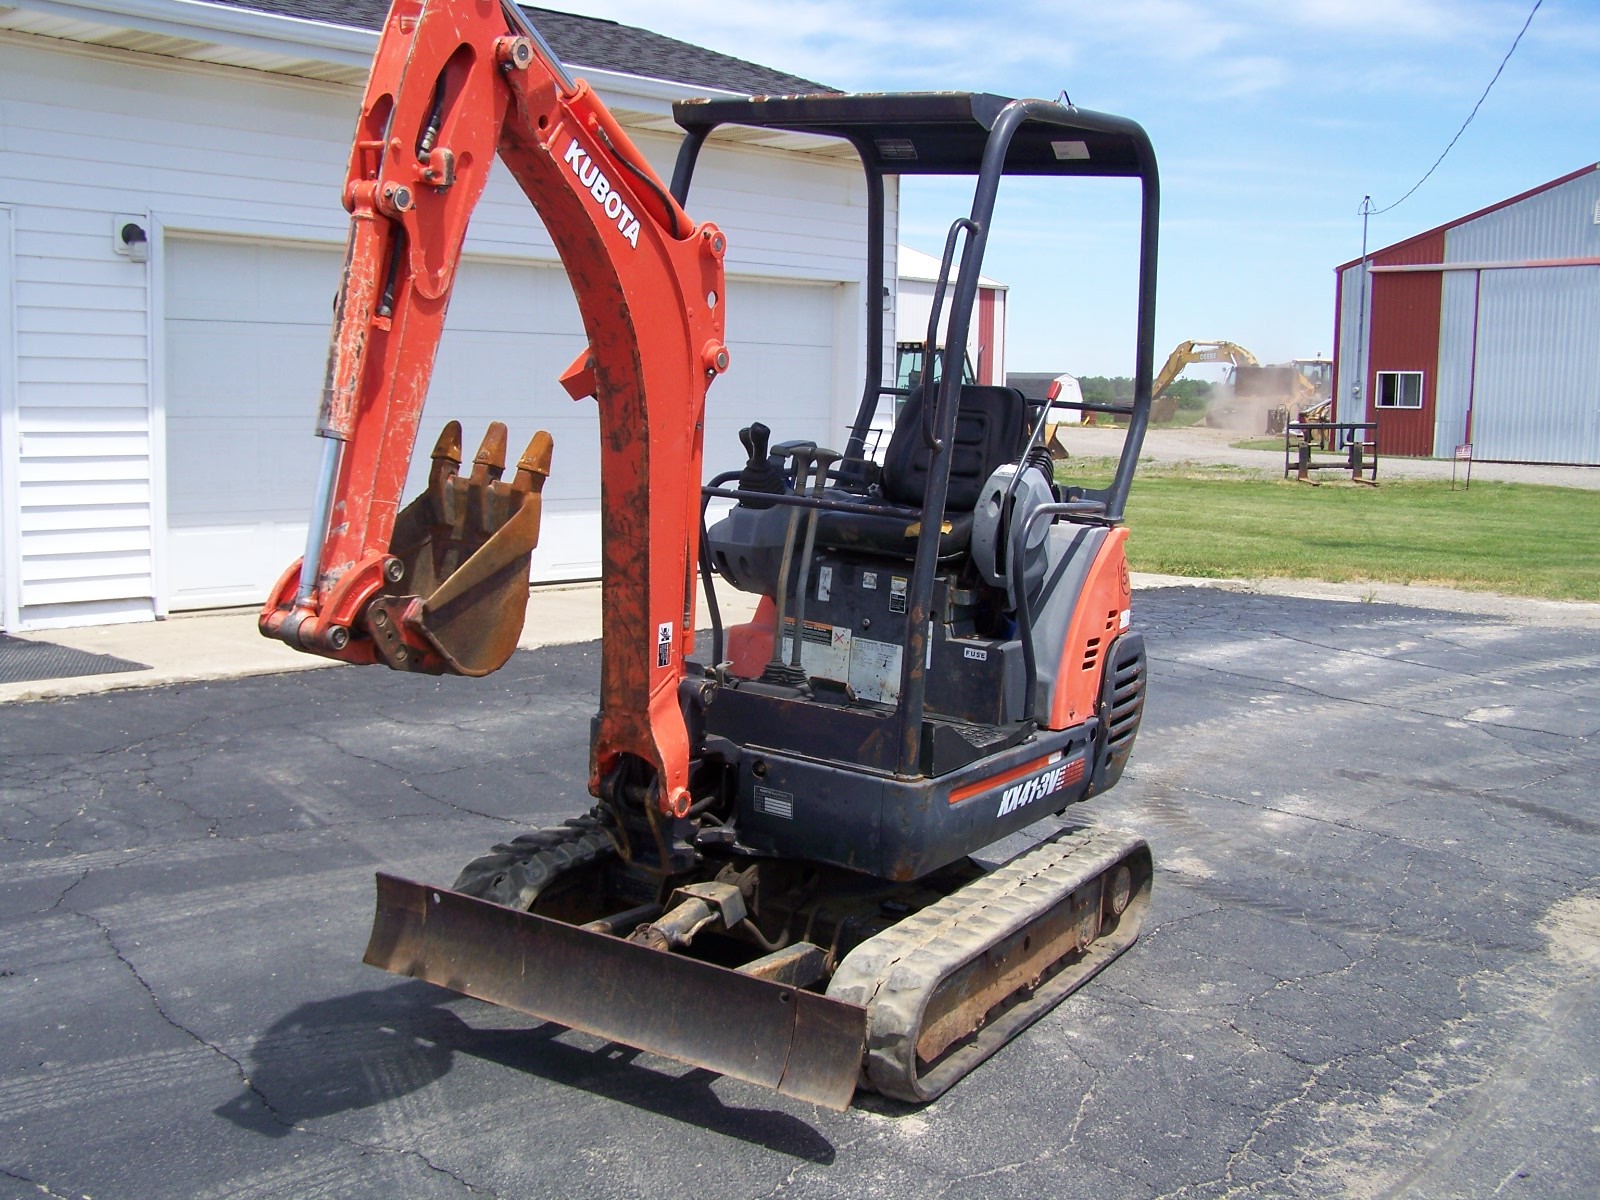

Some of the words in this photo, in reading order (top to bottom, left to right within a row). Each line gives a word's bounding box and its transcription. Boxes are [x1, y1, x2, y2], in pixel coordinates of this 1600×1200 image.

[563, 138, 641, 250] KUBOTA
[1199, 352, 1216, 360] DEERE
[965, 650, 986, 659] FUSE
[996, 767, 1063, 818] KX41-3V
